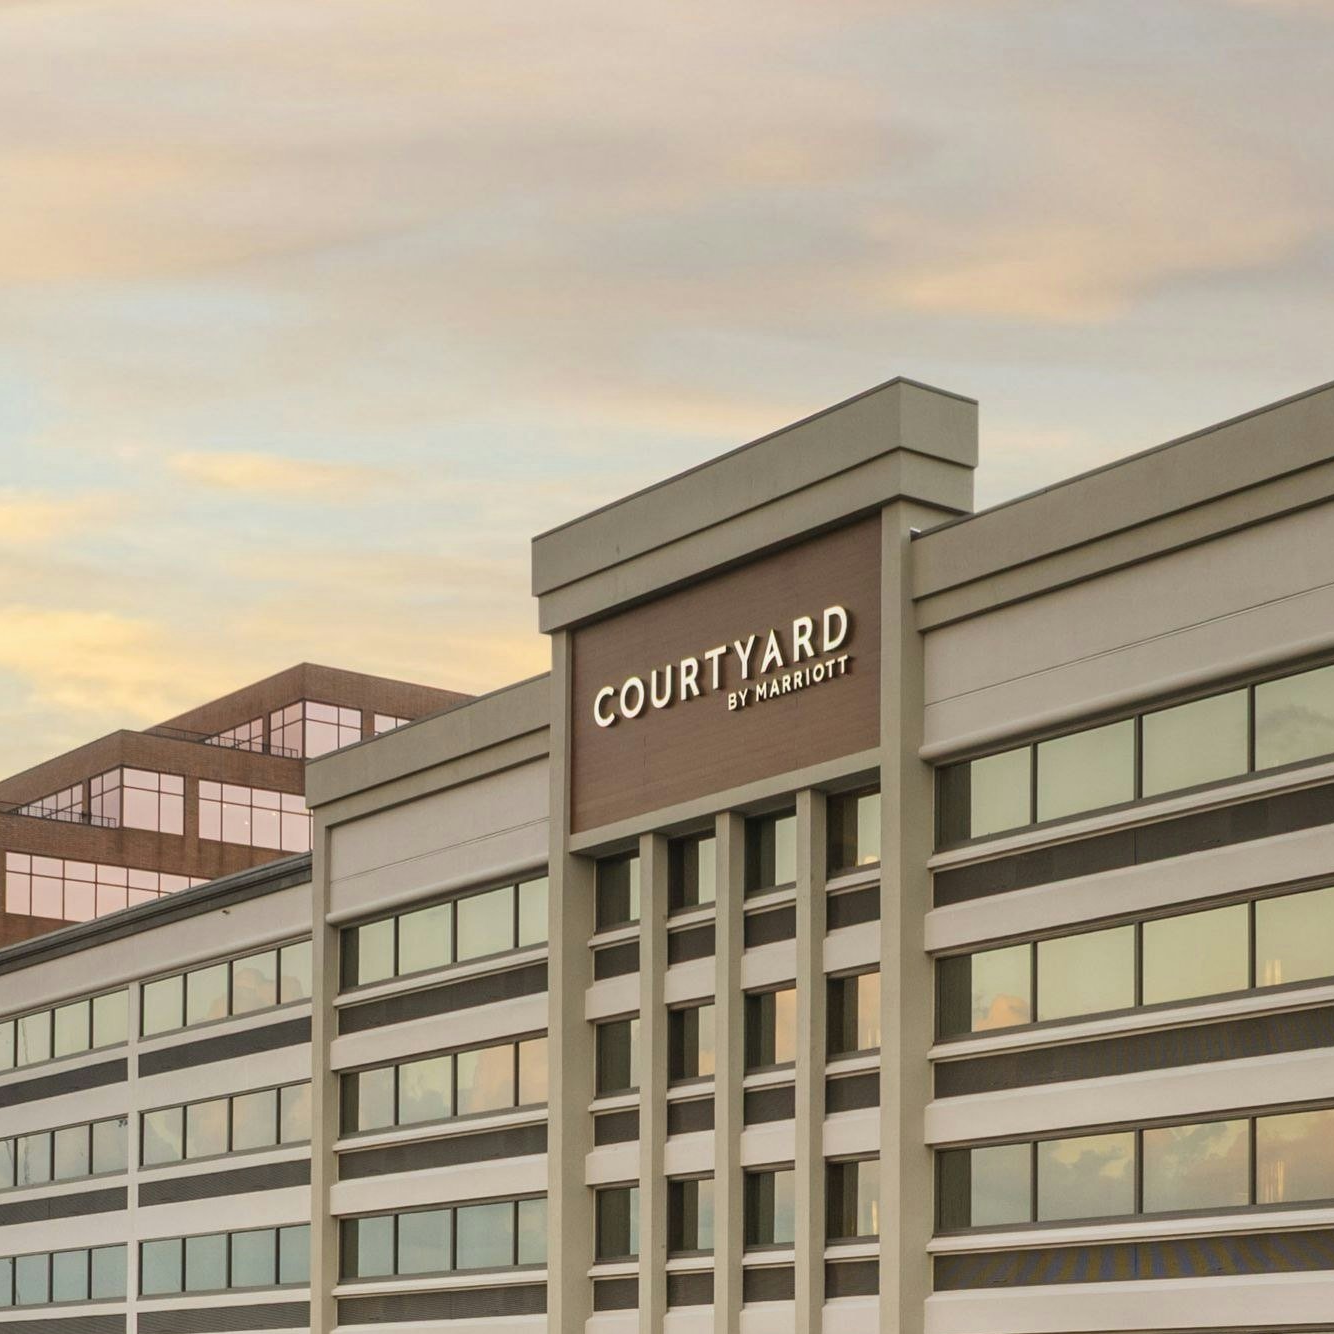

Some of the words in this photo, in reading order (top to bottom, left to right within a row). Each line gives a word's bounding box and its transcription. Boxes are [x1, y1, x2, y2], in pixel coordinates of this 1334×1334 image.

[593, 605, 848, 728] COURTYARD
[727, 688, 748, 711] BY
[755, 654, 848, 702] MARRIOTT
